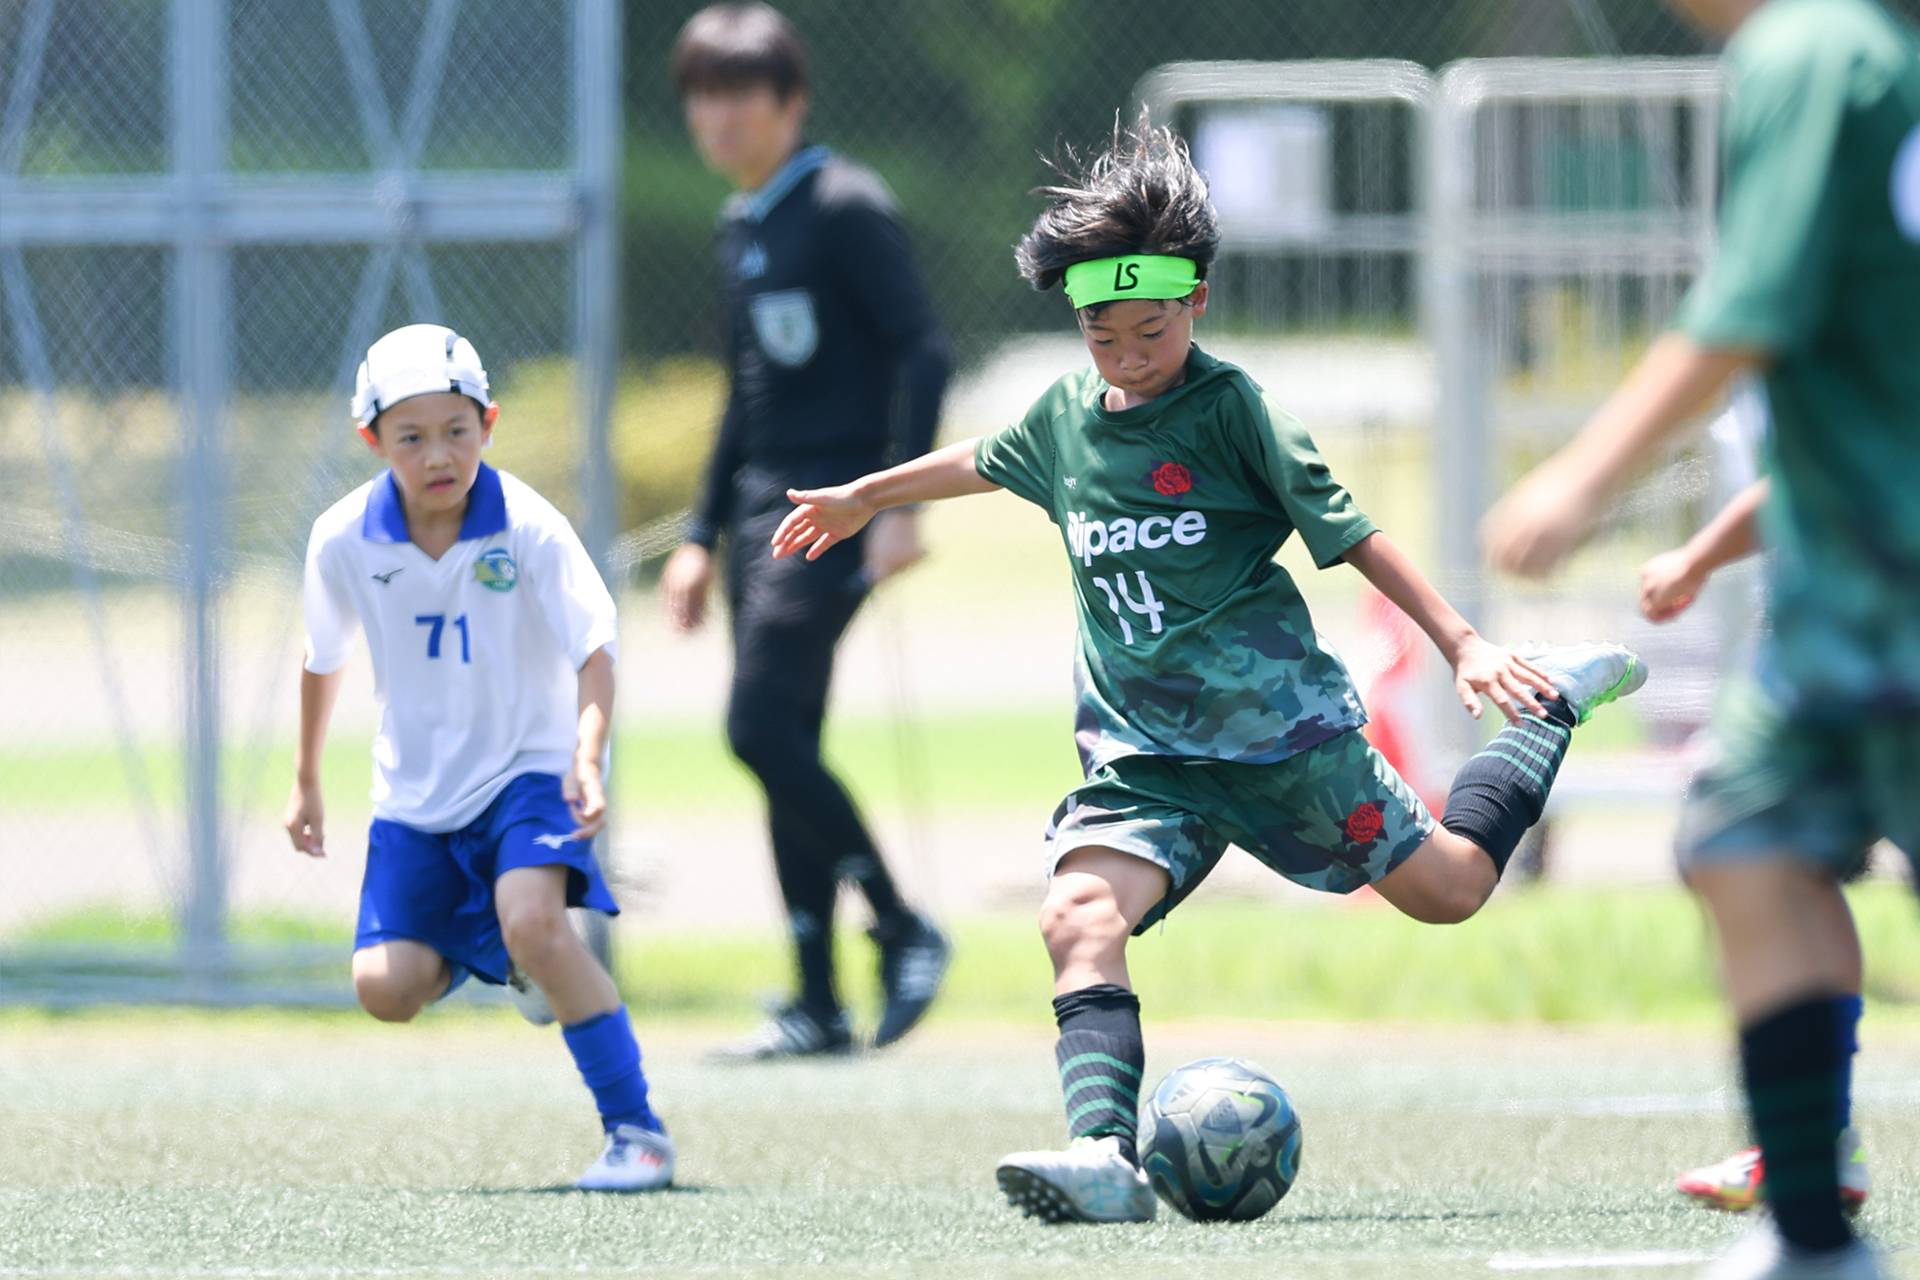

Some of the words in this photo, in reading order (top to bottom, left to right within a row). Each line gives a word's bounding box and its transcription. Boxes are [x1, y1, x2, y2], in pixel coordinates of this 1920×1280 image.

[1114, 263, 1140, 291] LS
[1092, 571, 1164, 645] 14
[415, 614, 470, 664] 71
